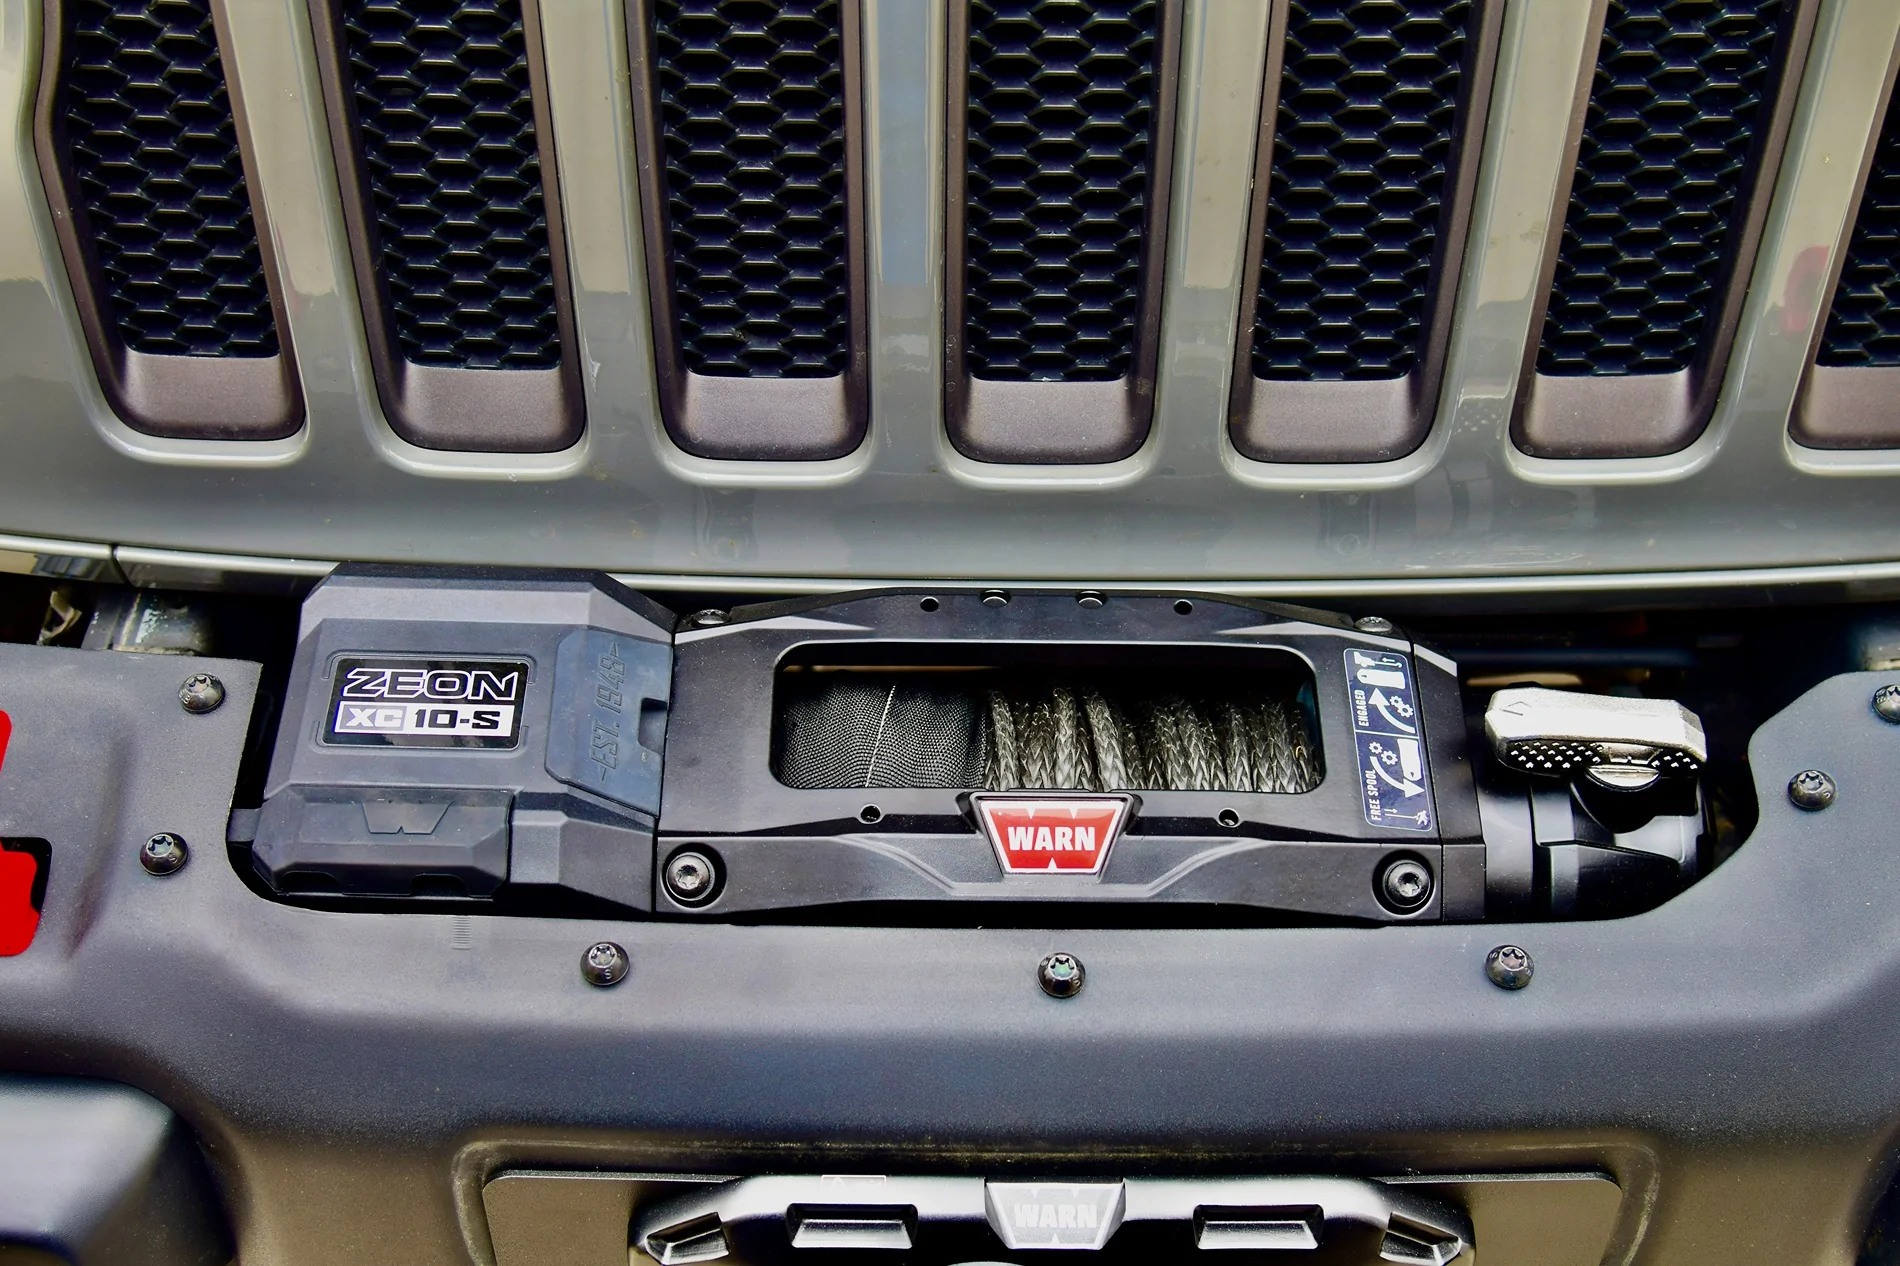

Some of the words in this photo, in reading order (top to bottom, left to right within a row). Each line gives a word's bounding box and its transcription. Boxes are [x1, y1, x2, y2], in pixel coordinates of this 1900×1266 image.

[342, 667, 519, 701] ZEON
[595, 653, 626, 714] 1948
[345, 708, 403, 728] XC
[414, 708, 501, 730] 10-S
[1358, 689, 1370, 728] ENGAGED
[590, 718, 621, 770] EST.
[1367, 769, 1380, 797] SPOOL
[1369, 798, 1382, 821] FREE
[1007, 826, 1096, 851] WARN
[1014, 1203, 1098, 1229] WARN
